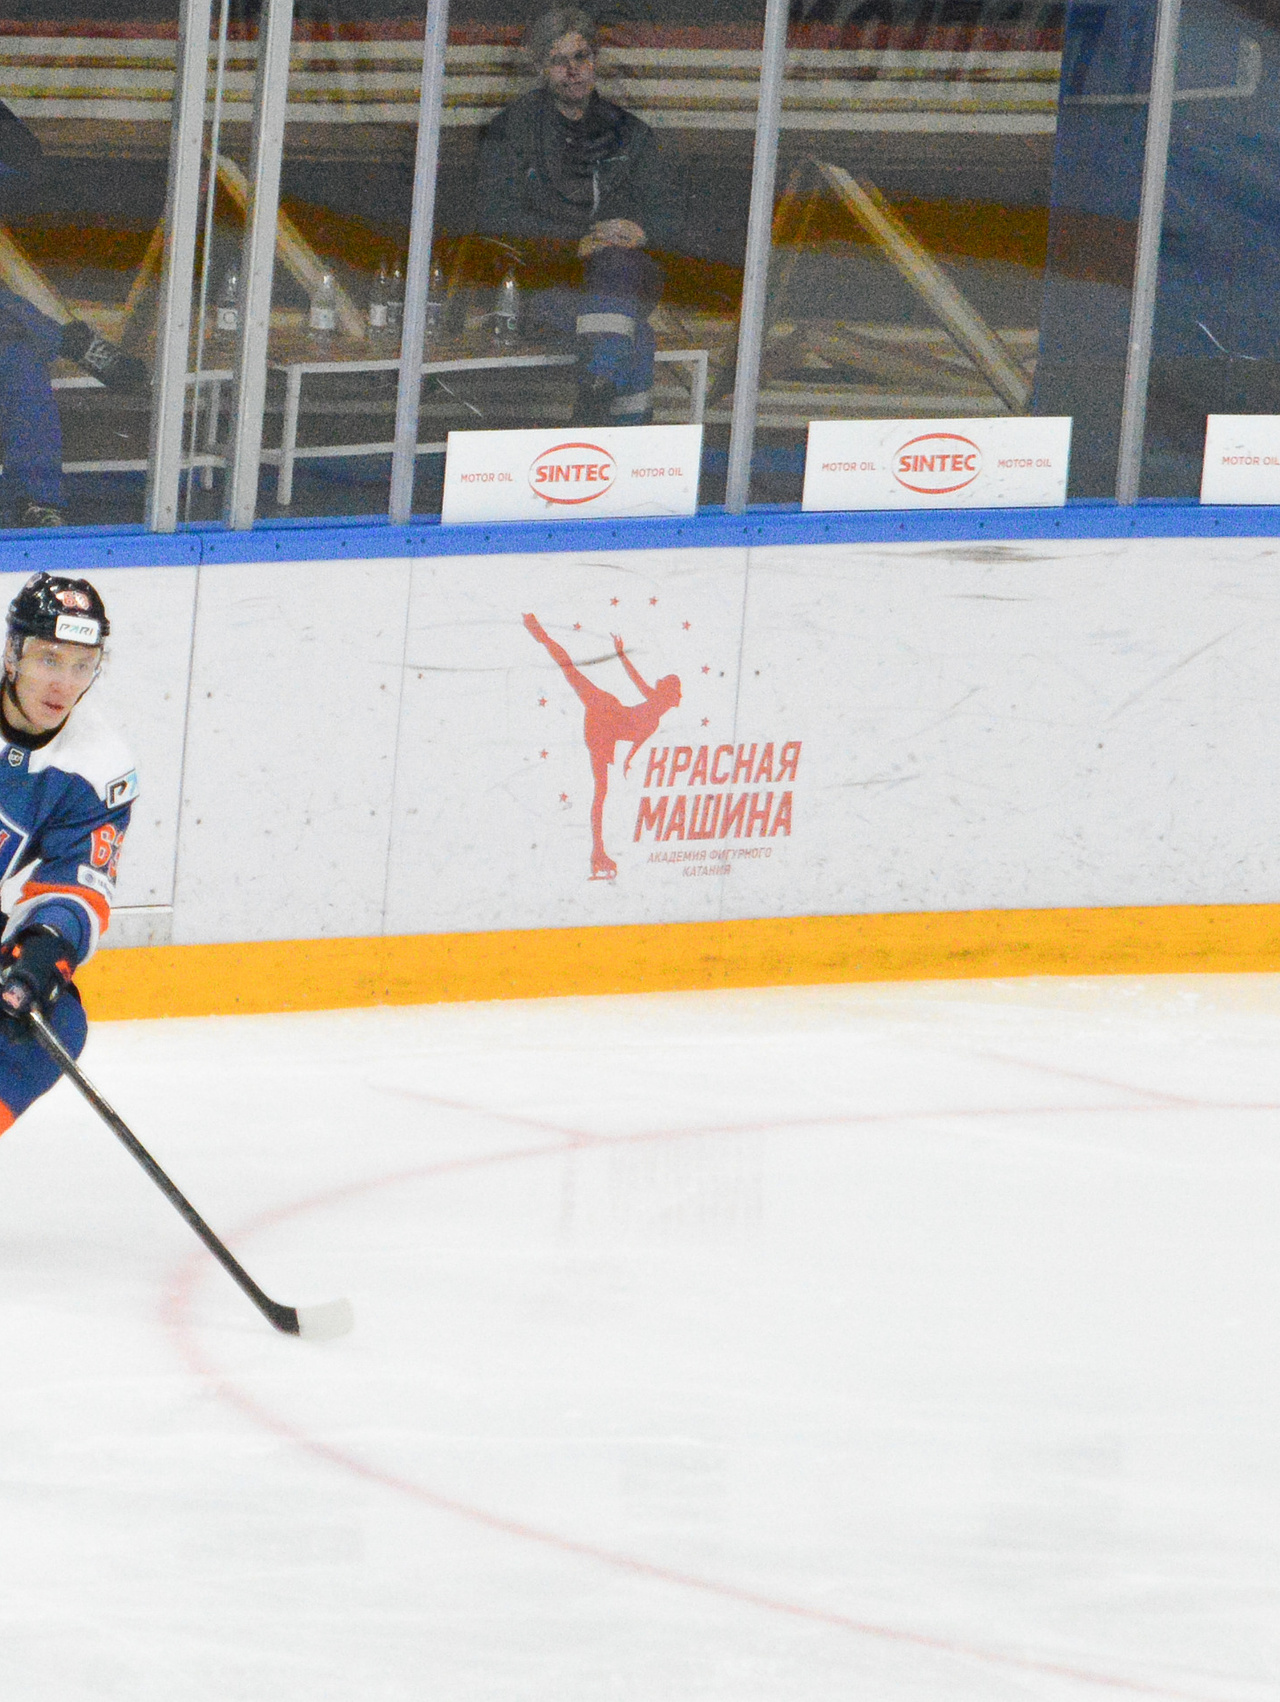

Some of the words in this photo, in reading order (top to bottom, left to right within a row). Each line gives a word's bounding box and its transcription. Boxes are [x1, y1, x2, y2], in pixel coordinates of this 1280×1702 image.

[822, 462, 857, 472] MOTOR
[860, 462, 876, 471] OIL
[898, 453, 977, 472] SINTEC
[997, 459, 1033, 468] MOTOR
[1035, 458, 1052, 468] OIL
[1222, 456, 1260, 466] MOTOR
[1263, 456, 1280, 466] OIL
[461, 473, 495, 483] MOTOR
[498, 472, 514, 482] OIL
[535, 463, 611, 483] SINTEC
[631, 468, 665, 478] MOTOR
[667, 467, 683, 477] OIL
[59, 623, 94, 636] PARI
[643, 741, 803, 788] КРАСНАЯ
[633, 791, 793, 843] МАШИНА
[647, 850, 707, 863] АКАДЕМИЯ
[709, 847, 772, 861] ФИГУРНОГО
[682, 864, 732, 877] КАТАНИЯ
